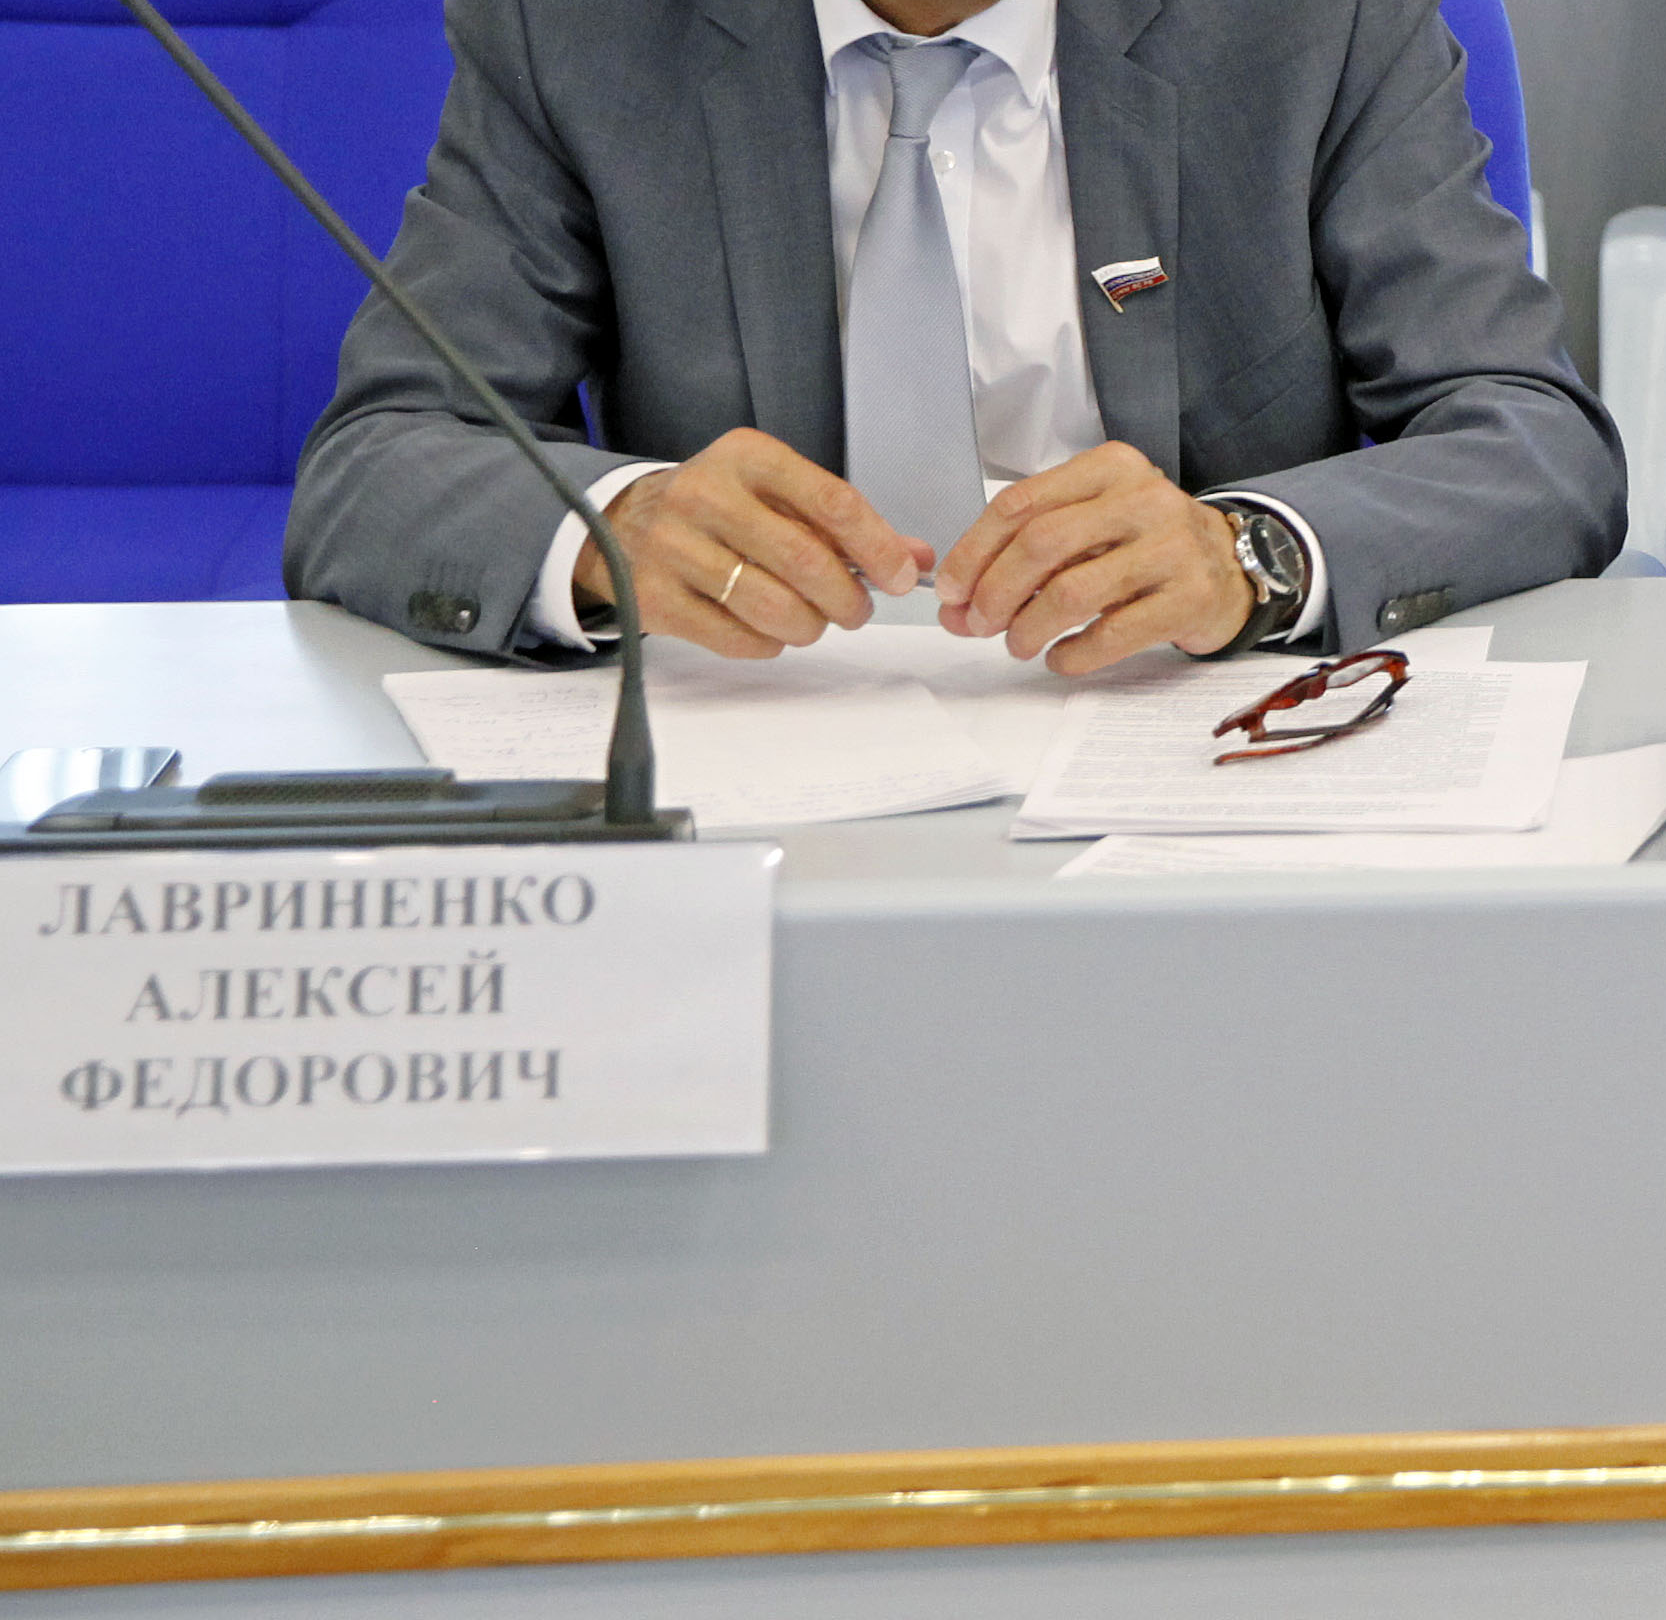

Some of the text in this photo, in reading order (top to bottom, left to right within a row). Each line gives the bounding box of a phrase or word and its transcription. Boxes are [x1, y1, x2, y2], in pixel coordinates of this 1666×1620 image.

[38, 874, 596, 937] ЛАВРИНЕНКО
[125, 949, 508, 1023] АЛЕКСЕЙ
[59, 1050, 564, 1119] ФЕДОРОВИЧ
